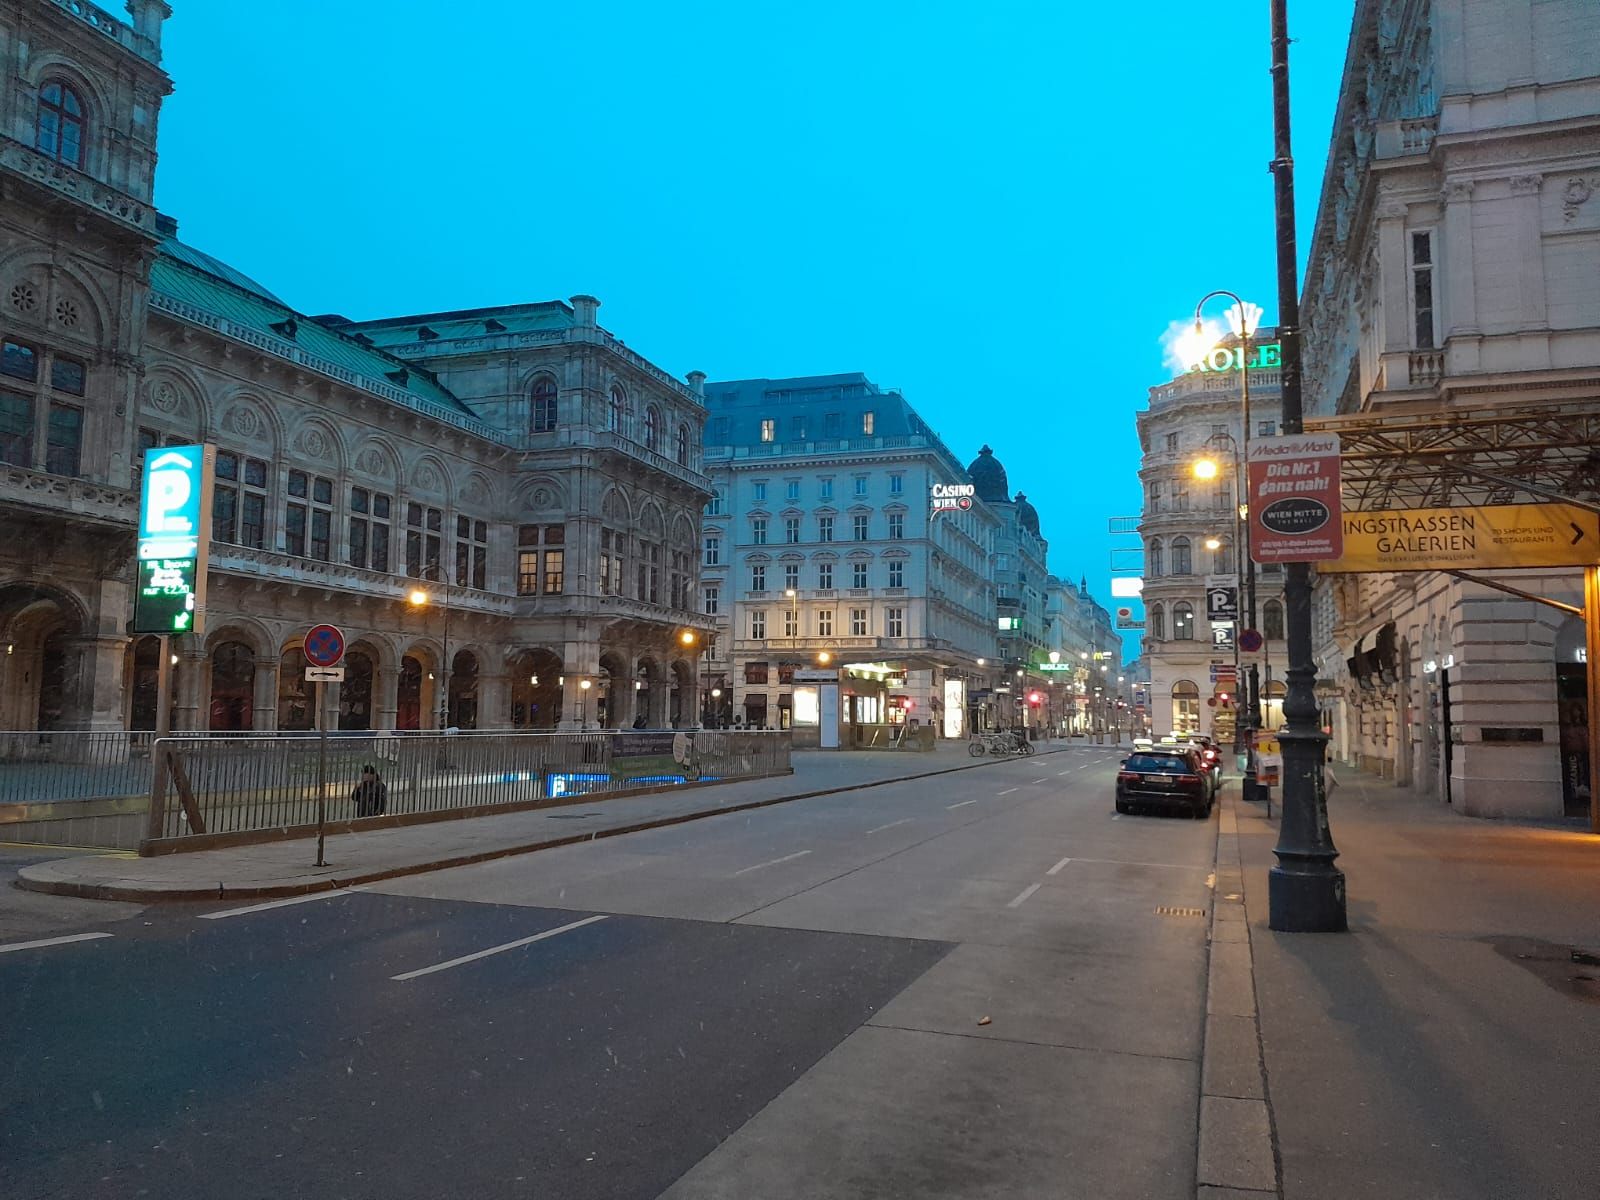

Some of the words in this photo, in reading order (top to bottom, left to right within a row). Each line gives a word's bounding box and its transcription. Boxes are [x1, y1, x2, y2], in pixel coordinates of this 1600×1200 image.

[1183, 344, 1281, 373] OLE
[1252, 445, 1289, 457] Media
[1298, 441, 1334, 453] Markt
[1267, 463, 1290, 477] Die
[1292, 461, 1320, 475] Nr.1
[1258, 480, 1294, 497] ganz
[1295, 476, 1330, 492] nah!
[933, 498, 957, 508] WIEN
[1267, 510, 1292, 519] WIEN
[1294, 508, 1323, 518] MITTE
[1343, 515, 1475, 535] INGSTRASSEN
[1503, 527, 1532, 535] SHOPS
[1376, 535, 1476, 553] GALERIEN
[1493, 536, 1554, 545] RESTAURANTS
[1040, 663, 1070, 671] ROLEX
